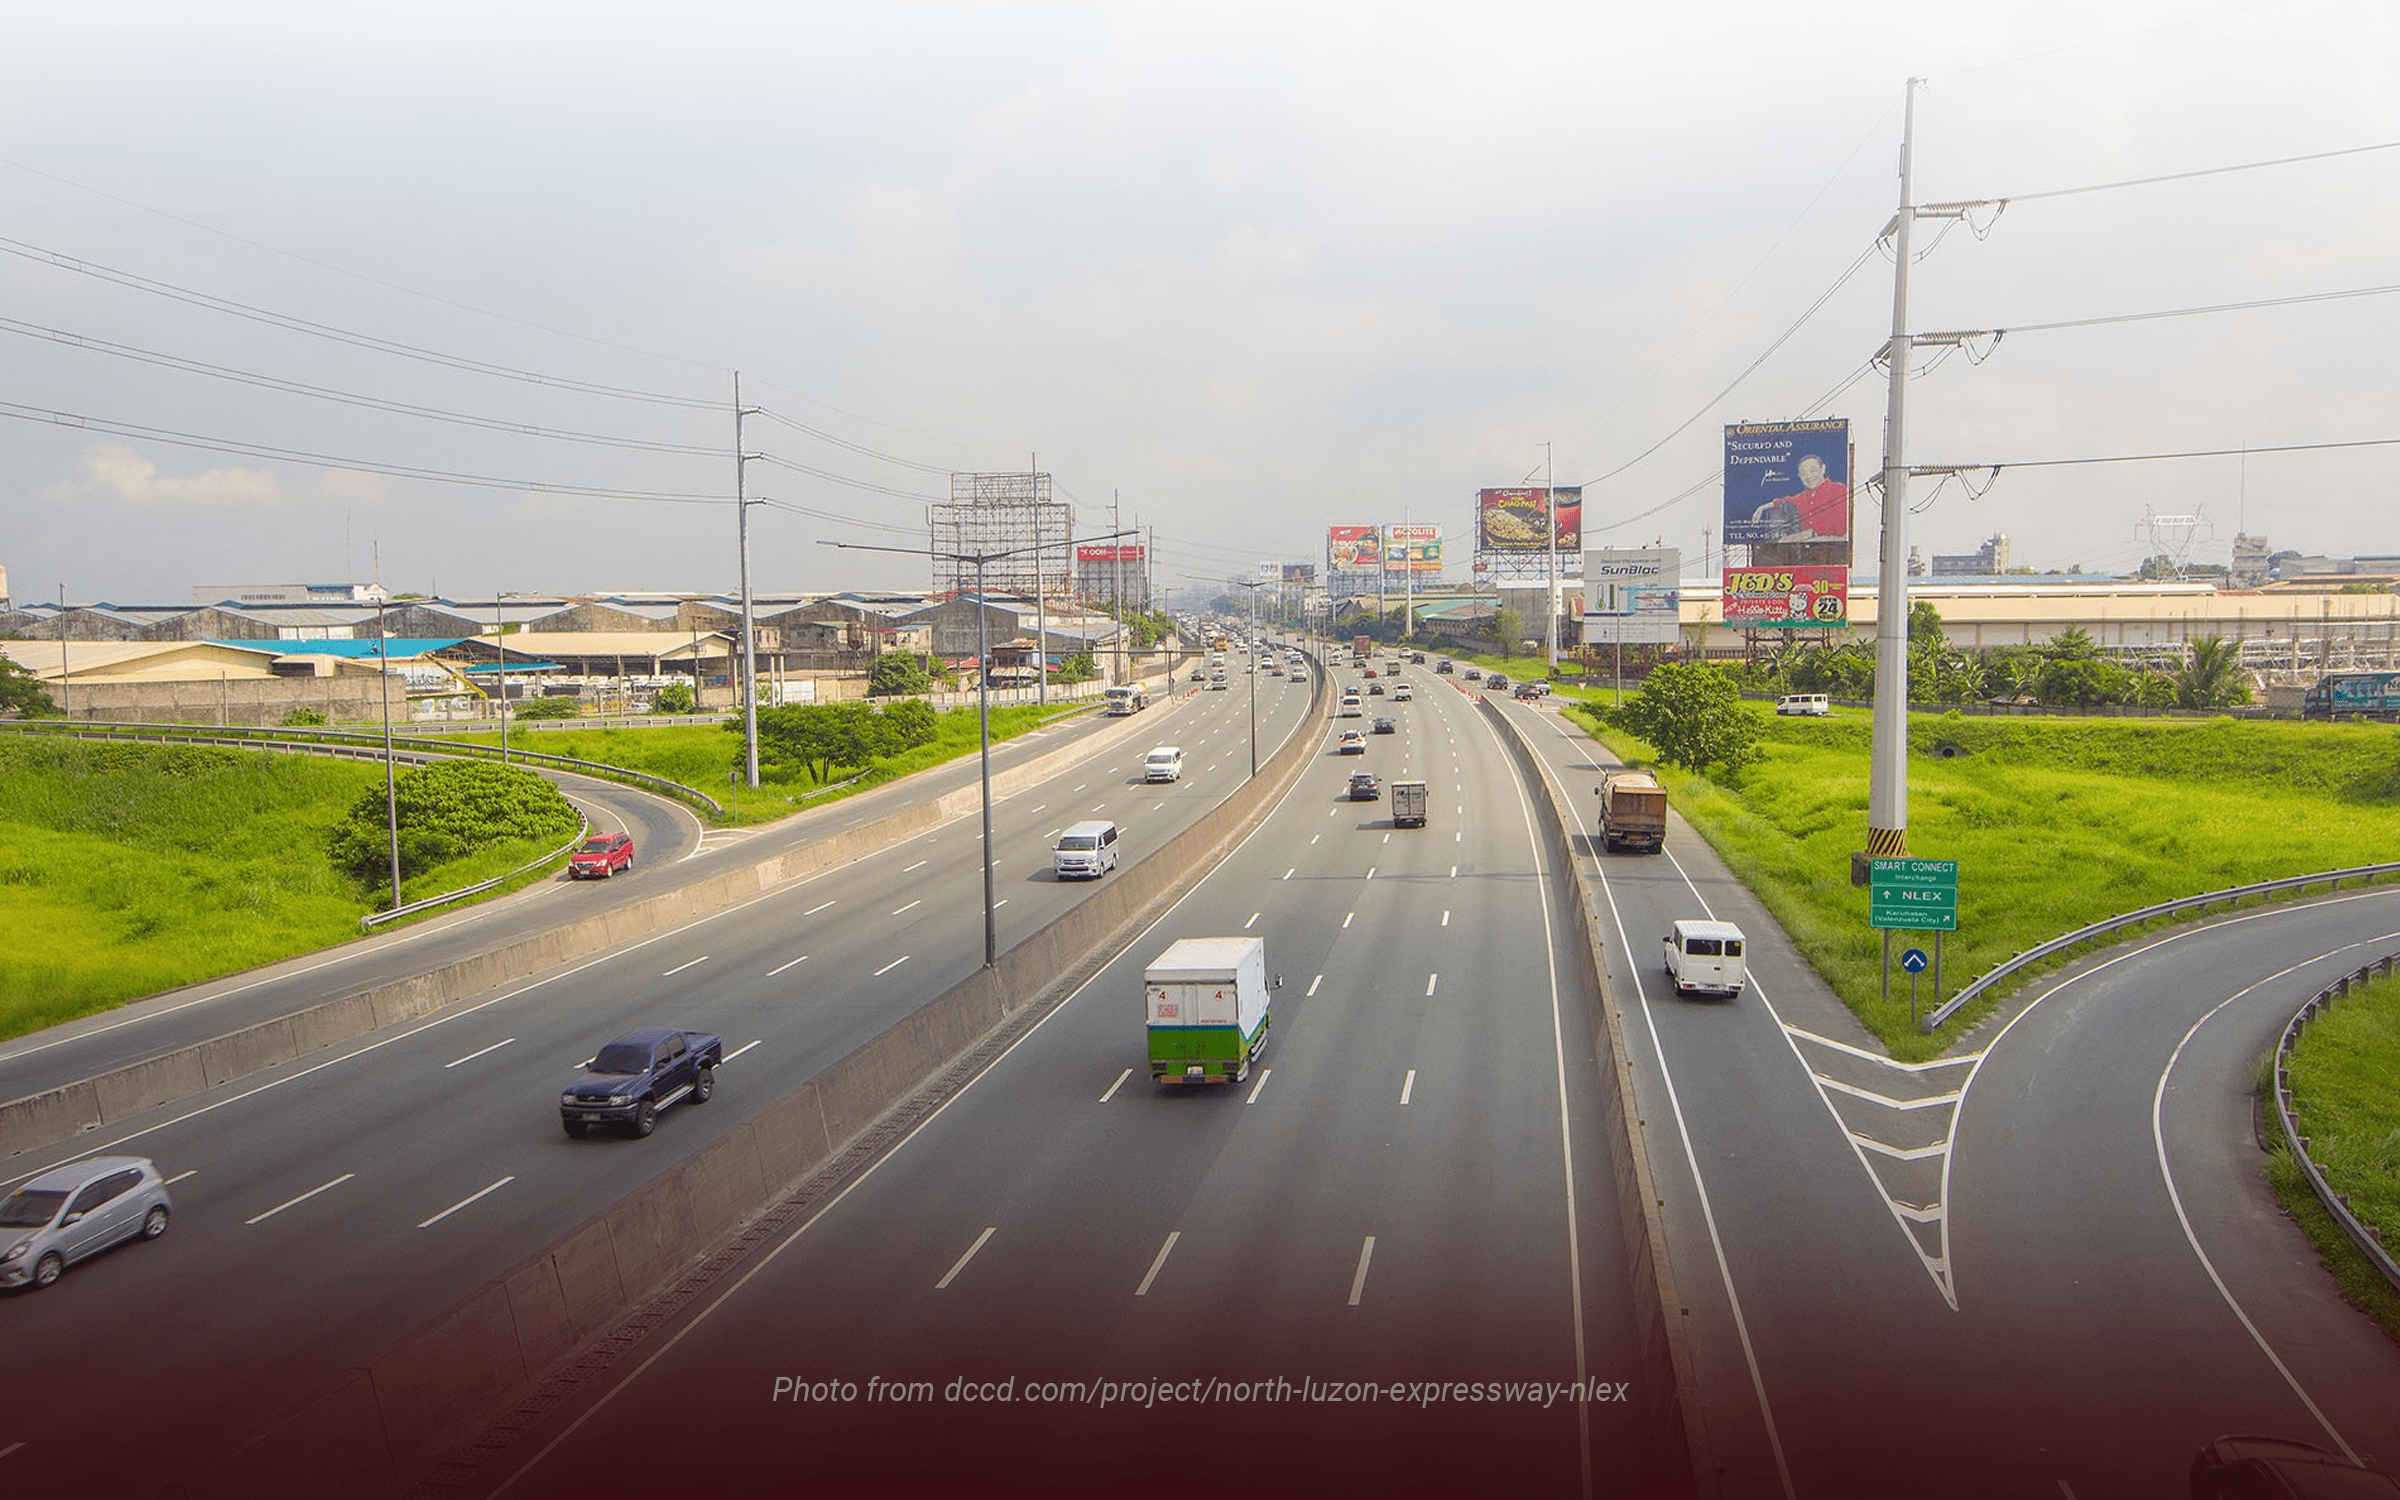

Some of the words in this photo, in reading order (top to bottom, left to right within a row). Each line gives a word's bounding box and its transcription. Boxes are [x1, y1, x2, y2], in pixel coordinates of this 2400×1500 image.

[1736, 423, 1785, 435] ORIENTAL
[1786, 420, 1845, 432] ASSURANCE
[1773, 440, 1792, 449] AND
[1725, 572, 1794, 595] JED'S
[1812, 580, 1829, 594] 30
[1818, 602, 1838, 615] 24
[1874, 861, 1906, 871] SMART
[1911, 862, 1954, 872] CONNECT
[1895, 874, 1937, 882] Interchange
[1902, 892, 1941, 901] NLEX
[1921, 916, 1940, 924] City)
